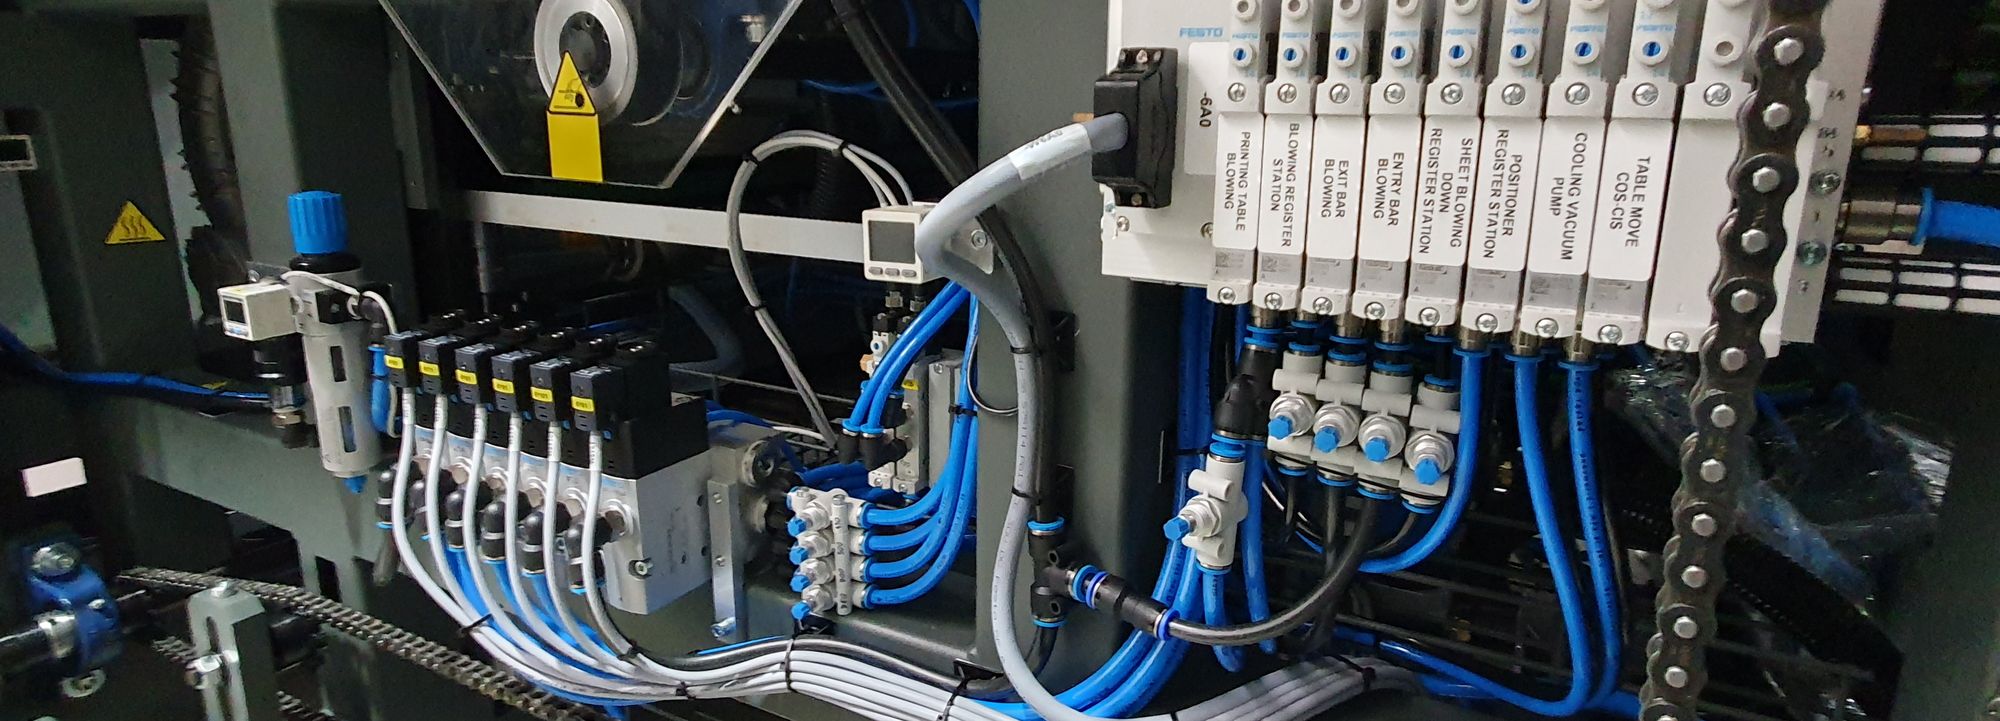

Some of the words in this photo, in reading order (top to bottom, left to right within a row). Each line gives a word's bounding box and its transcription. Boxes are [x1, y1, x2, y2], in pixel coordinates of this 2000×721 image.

[1179, 27, 1223, 38] FESTO
[1199, 91, 1213, 127] -6A0
[1224, 152, 1236, 209] BLOWING
[1238, 131, 1251, 188] PRINTING
[1286, 123, 1300, 182] BLOWING
[1337, 160, 1349, 188] EXIT
[1390, 152, 1405, 195] ENTRY
[1424, 128, 1442, 195] REGISTER
[1458, 138, 1474, 182] SHEET
[1490, 129, 1510, 198] REGISTER
[1567, 132, 1588, 197] COOLING
[1631, 156, 1651, 202] TABLE
[1236, 194, 1247, 231] TABLE
[1270, 159, 1283, 211] STATION
[1321, 158, 1335, 218] BLOWING
[1335, 191, 1347, 218] BAR
[1373, 158, 1389, 219] BLOWING
[1387, 199, 1400, 226] BAR
[1438, 172, 1453, 213] DOWN
[1502, 154, 1523, 236] POSITIONER
[1549, 177, 1565, 216] PUMP
[1281, 185, 1295, 247] REGISTER
[1418, 198, 1434, 254] STATION
[1450, 186, 1468, 248] BLOWING
[1483, 201, 1500, 259] STATION
[1560, 201, 1580, 260] VACUUM
[1625, 207, 1644, 247] MOVE
